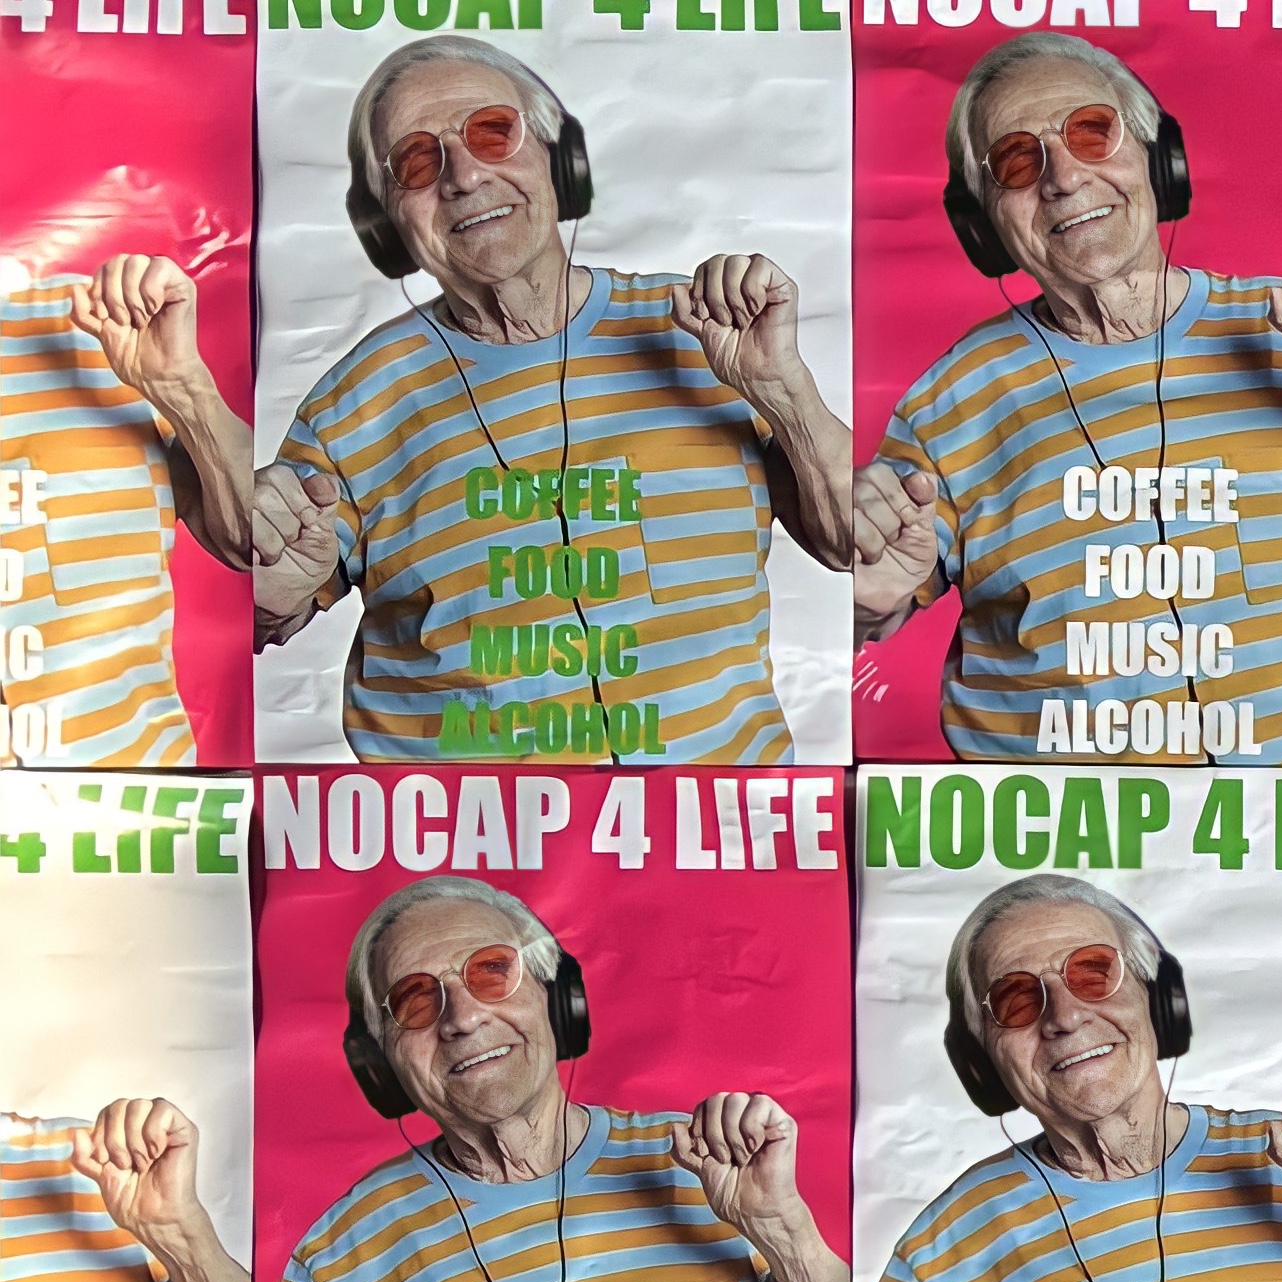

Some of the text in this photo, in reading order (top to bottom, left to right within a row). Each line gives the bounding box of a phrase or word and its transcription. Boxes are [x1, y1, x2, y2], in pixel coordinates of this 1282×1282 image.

[465, 467, 641, 522] COFFEE
[1062, 467, 1238, 524] COFFEE
[488, 546, 619, 599] FOOD
[1084, 546, 1214, 599] FOOD
[469, 624, 637, 678] MUSIC
[1066, 623, 1232, 678] MUSIC
[438, 702, 666, 757] ALCOHOL
[1036, 700, 1261, 756] ALCOHOL
[72, 784, 245, 874] LIFE
[264, 775, 837, 871] NOCAP 4 LIFE
[867, 775, 1170, 870] NOCAP
[1193, 779, 1249, 870] 4
